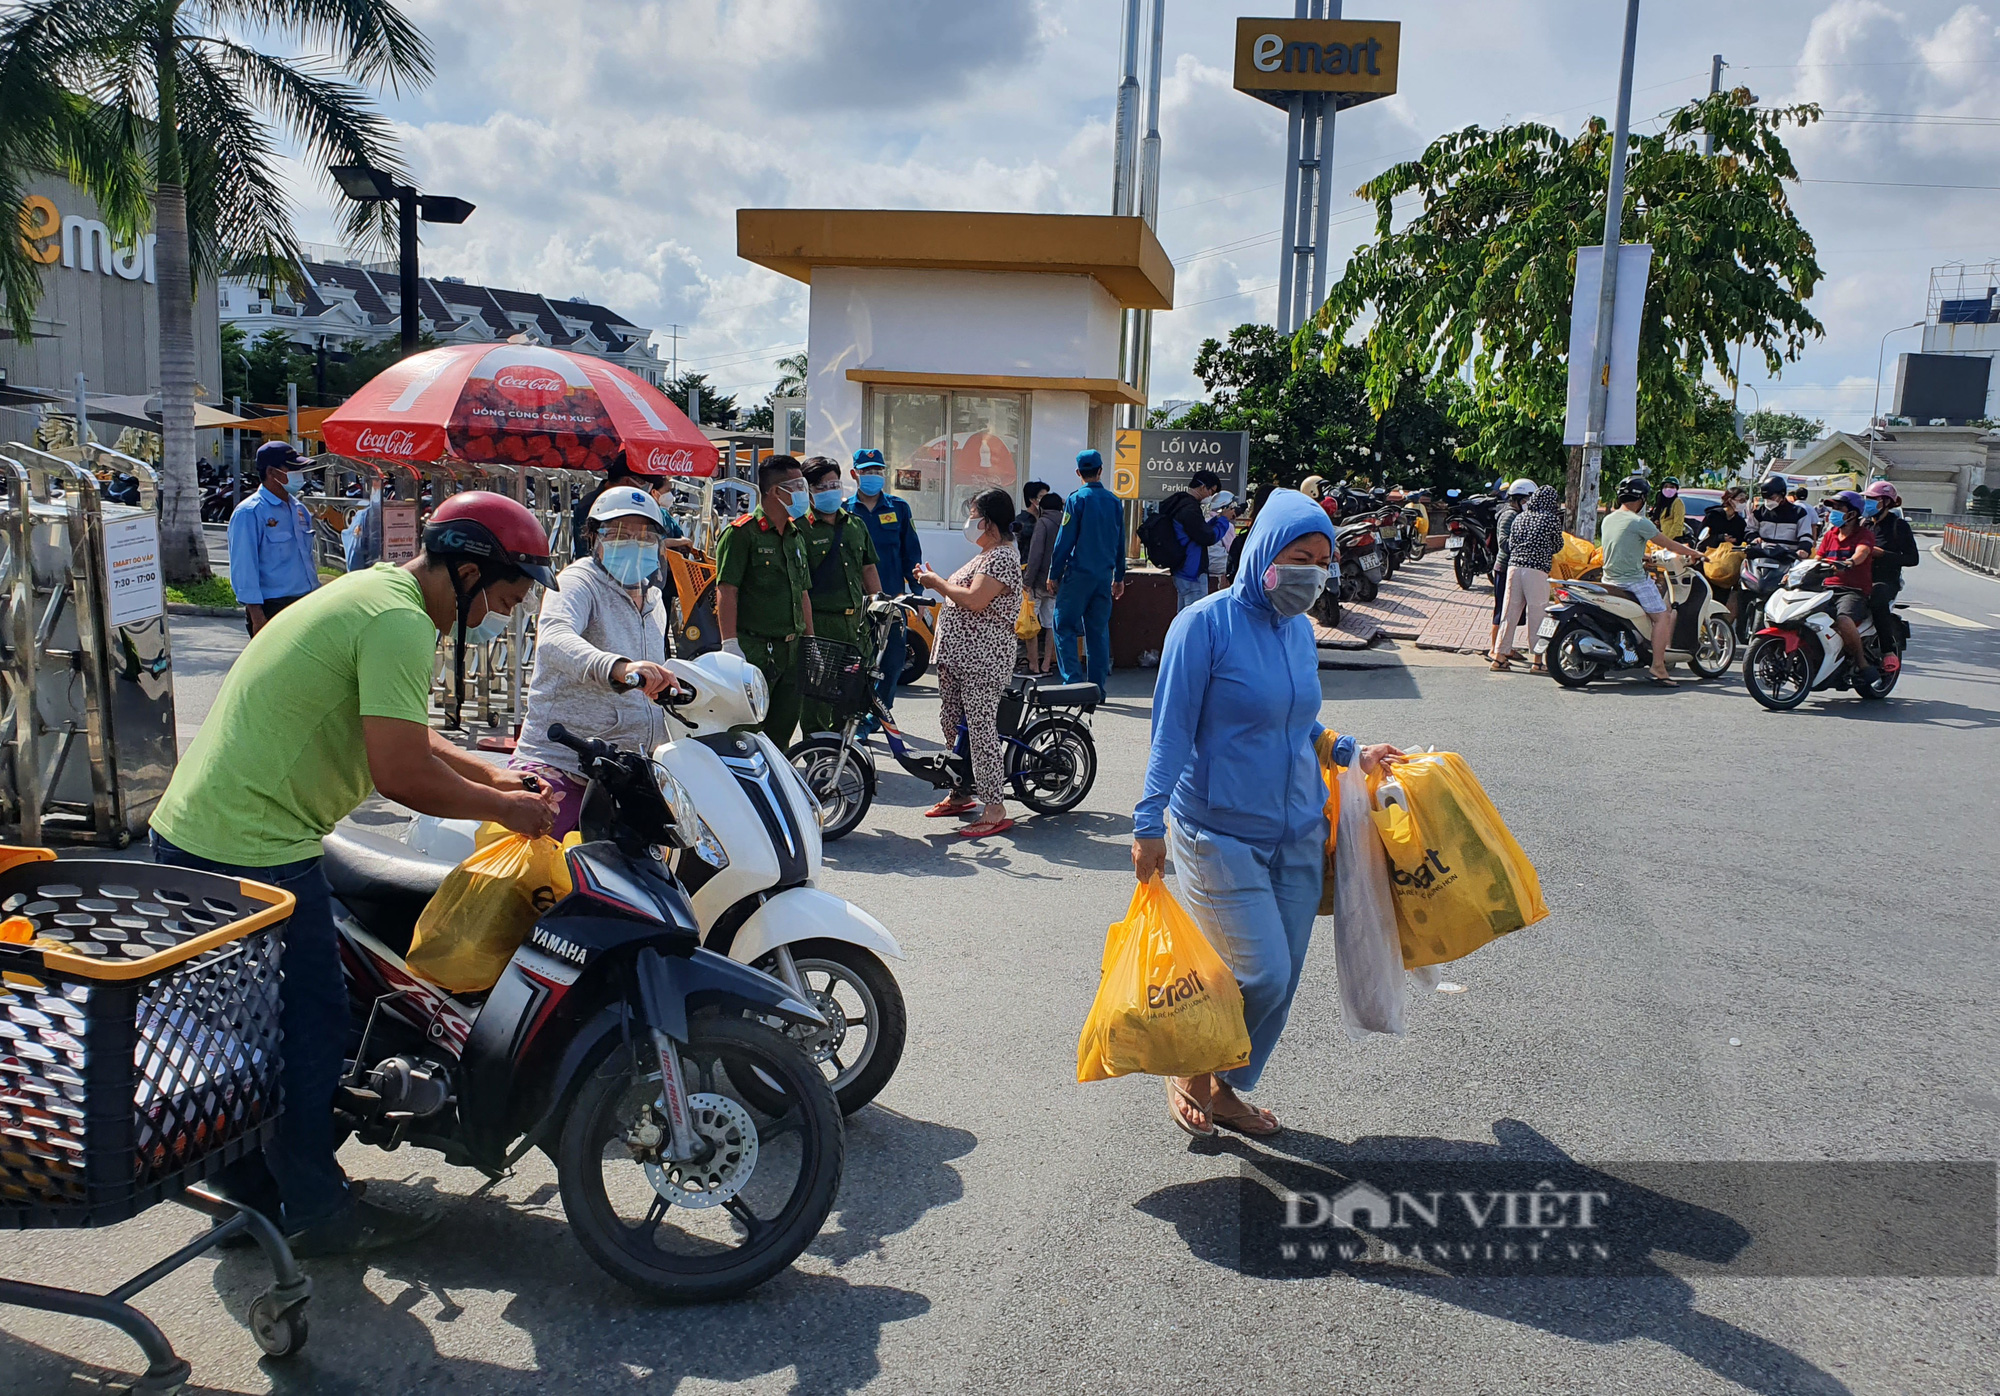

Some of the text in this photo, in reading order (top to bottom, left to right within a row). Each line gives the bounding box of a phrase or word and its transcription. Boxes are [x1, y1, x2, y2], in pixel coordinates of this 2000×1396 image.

[1253, 33, 1382, 76] emart
[18, 195, 157, 284] emar
[1161, 437, 1221, 455] LỐI VÀO
[1146, 457, 1234, 474] ÔTÔ & XE MÁY
[1161, 483, 1191, 493] Parkin
[114, 577, 131, 589] 7:30
[136, 572, 156, 584] 17:00
[531, 926, 588, 965] YAMAHA
